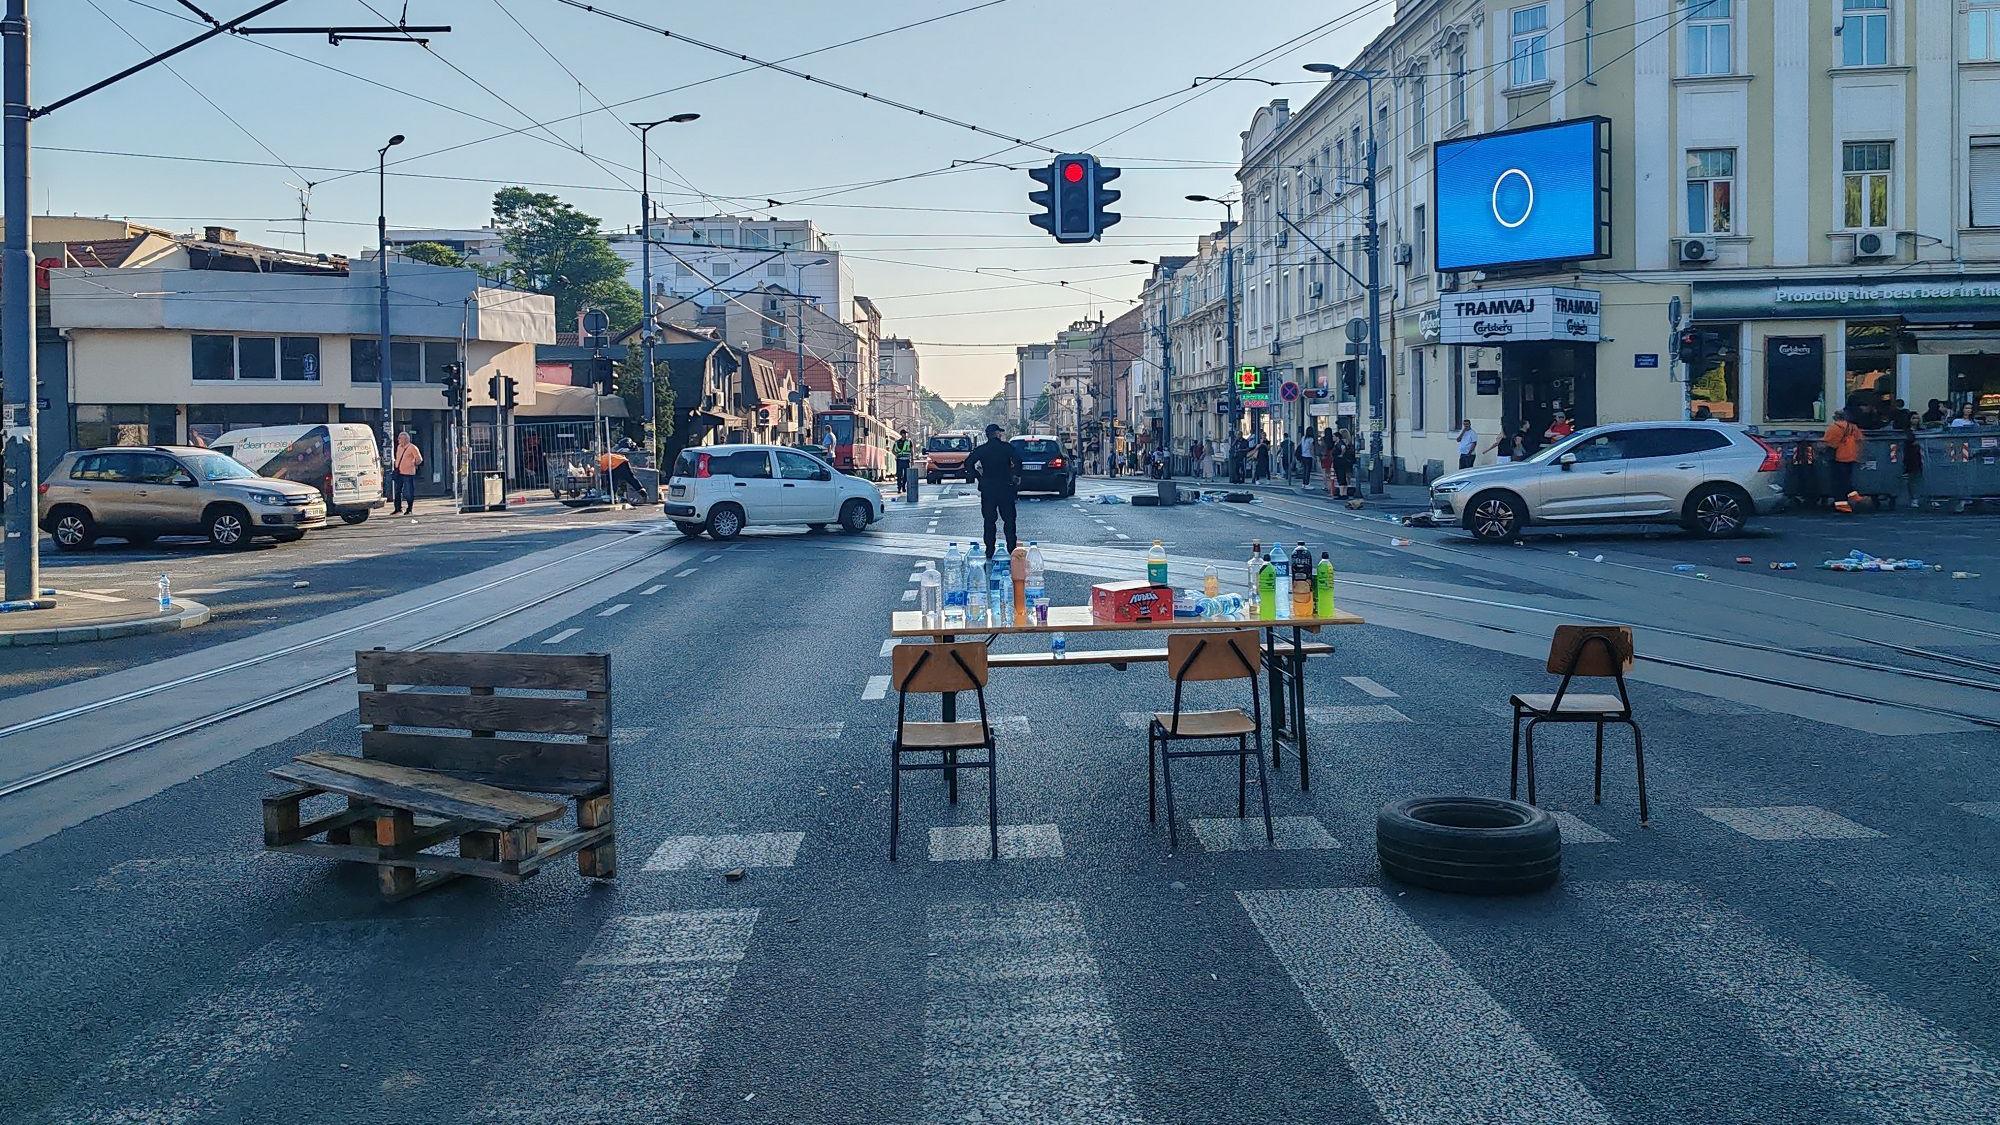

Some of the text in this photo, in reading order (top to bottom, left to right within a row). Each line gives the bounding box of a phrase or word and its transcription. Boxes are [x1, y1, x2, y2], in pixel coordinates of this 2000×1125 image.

[1854, 286, 1879, 300] the
[1454, 298, 1535, 316] TRAMVAJ
[1555, 298, 1598, 315] TRAMVAJ
[1473, 320, 1513, 338] Carlsberg
[1779, 343, 1811, 357] Carlsberg
